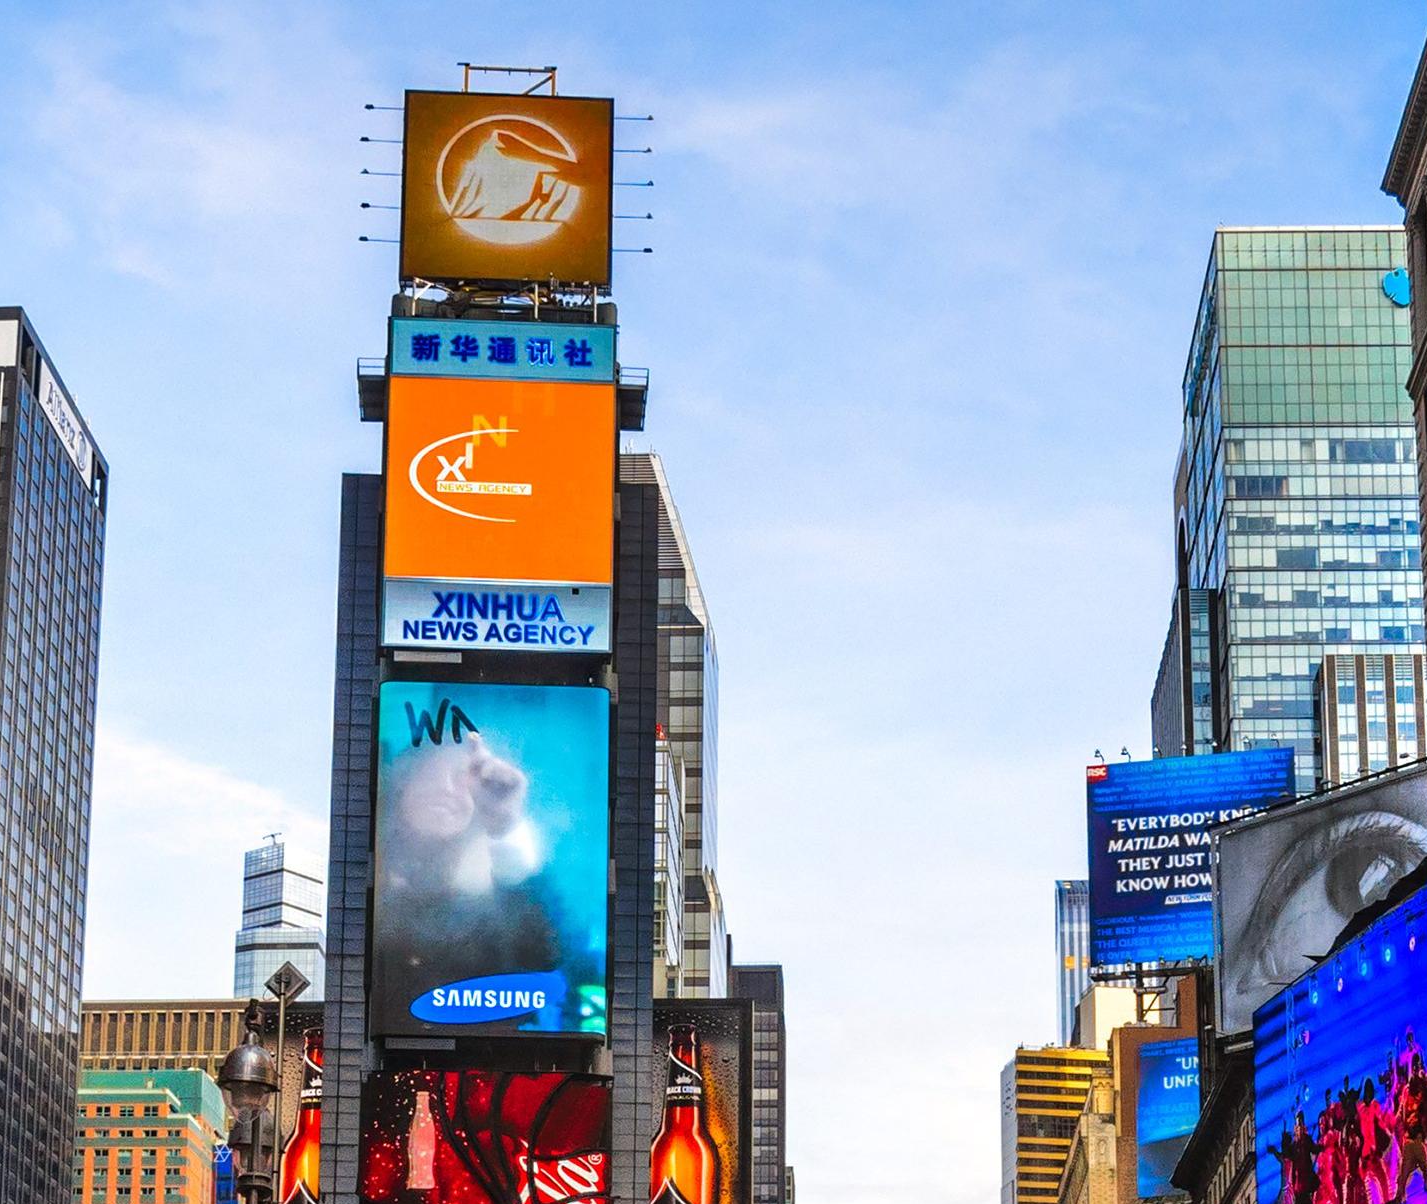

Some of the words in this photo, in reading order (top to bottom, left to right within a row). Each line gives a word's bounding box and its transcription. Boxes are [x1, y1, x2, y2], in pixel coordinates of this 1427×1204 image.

[410, 331, 594, 369] 新华通讯社
[438, 482, 473, 494] NEWS
[478, 483, 529, 496] AGENCY
[431, 590, 565, 623] XINHUA
[402, 619, 479, 643] NEWS
[483, 620, 596, 648] AGENCY
[1107, 834, 1180, 854] MATILDA
[1117, 855, 1162, 872] THEY
[1165, 852, 1205, 869] JUST
[1116, 875, 1170, 894] KNOW
[1173, 872, 1213, 889] HOW
[431, 987, 546, 1010] SAMSUNG
